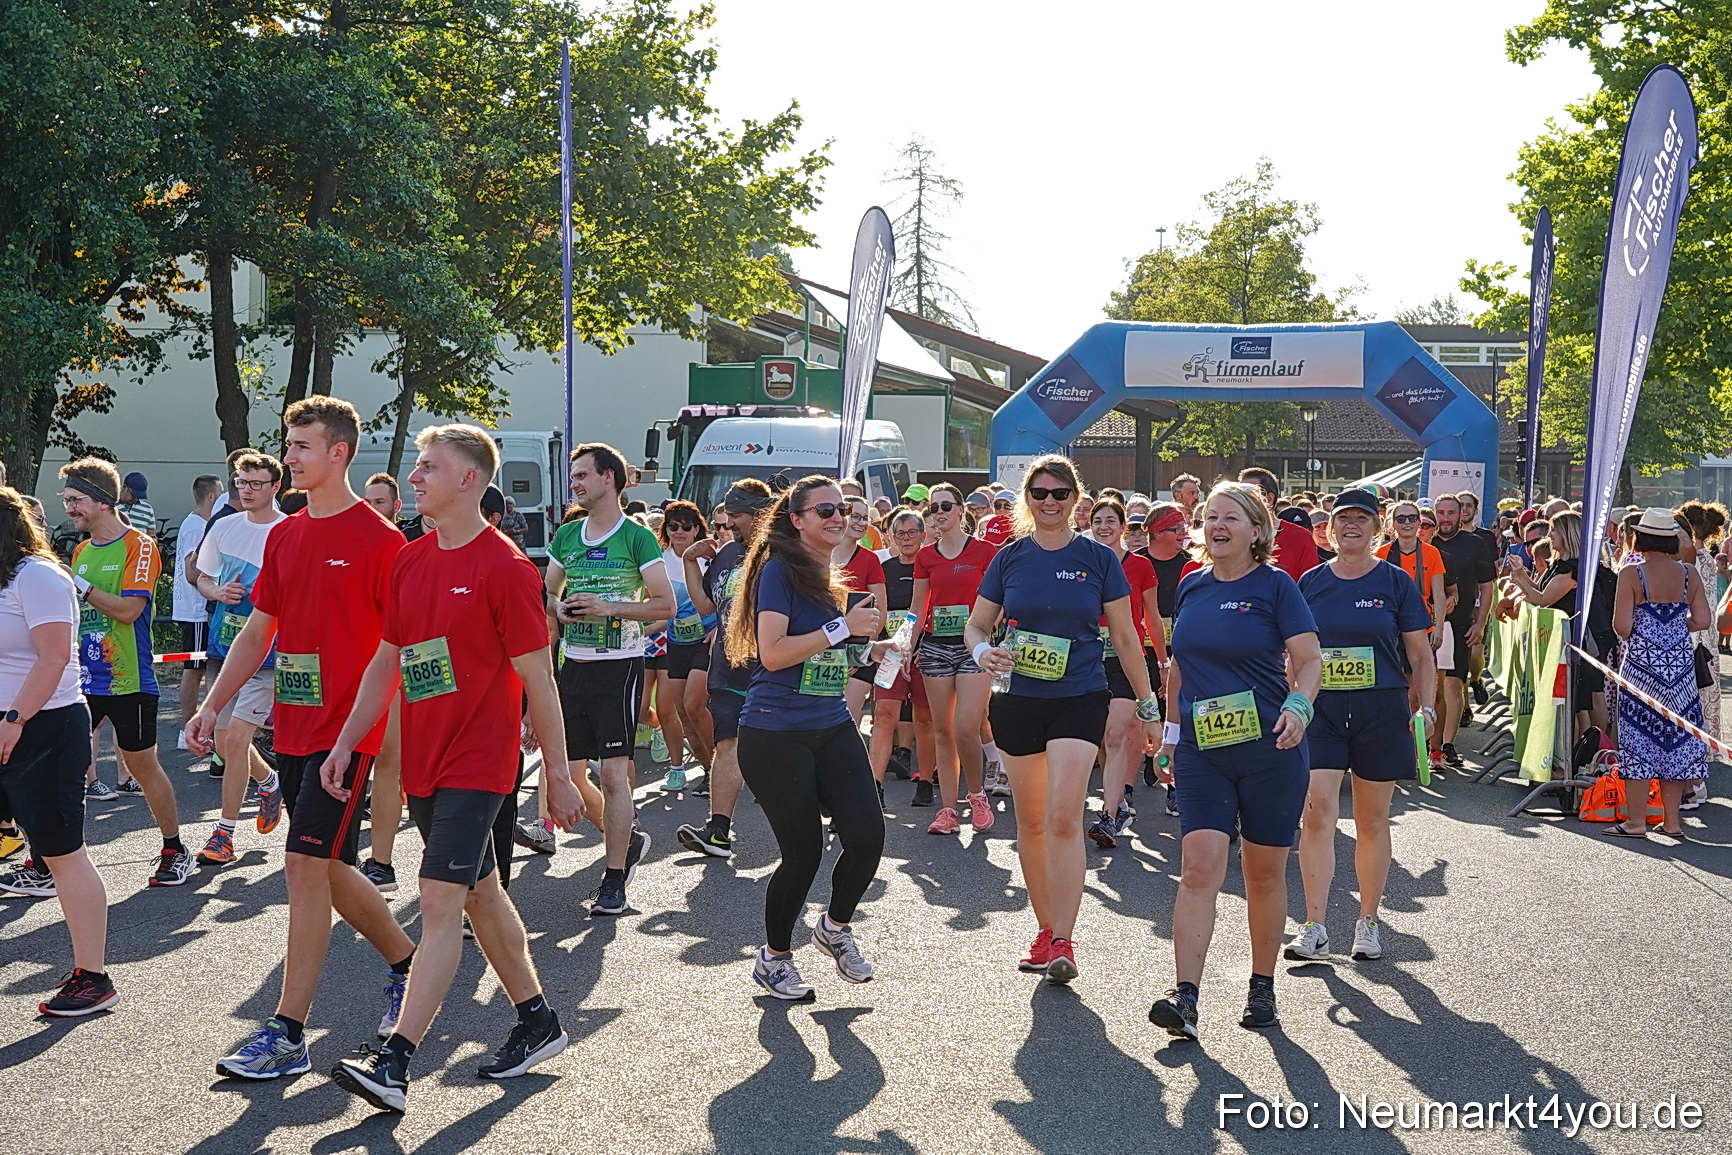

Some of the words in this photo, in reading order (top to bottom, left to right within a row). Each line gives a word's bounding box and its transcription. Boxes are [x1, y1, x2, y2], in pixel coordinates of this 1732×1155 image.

[1635, 108, 1678, 251] Fischer
[1652, 132, 1684, 247] AUTOMOBILE
[1240, 344, 1270, 352] Fischer
[1216, 360, 1305, 377] firmenlauf
[1045, 386, 1093, 397] Fischer
[1391, 390, 1404, 398] und
[1405, 388, 1418, 396] das
[702, 443, 743, 452] abavent
[775, 447, 833, 456] DATASPORT
[575, 559, 627, 569] firmenlauf
[1055, 569, 1076, 580] vhs
[1219, 600, 1239, 610] vhs
[1354, 599, 1374, 608] vhs
[571, 622, 594, 636] 304
[939, 616, 960, 627] 237
[1020, 646, 1058, 667] 1426
[405, 658, 442, 684] 1686
[440, 659, 452, 686] 2022
[813, 664, 845, 681] 1425
[1326, 661, 1366, 677] 1428
[279, 670, 312, 689] 1698
[311, 674, 320, 699] 2022
[1203, 709, 1246, 733] 1427
[1247, 709, 1258, 733] 2022
[1197, 719, 1206, 744] WALK
[1206, 731, 1231, 740] Sommer
[1231, 727, 1250, 735] Helga
[300, 835, 323, 845] adidas
